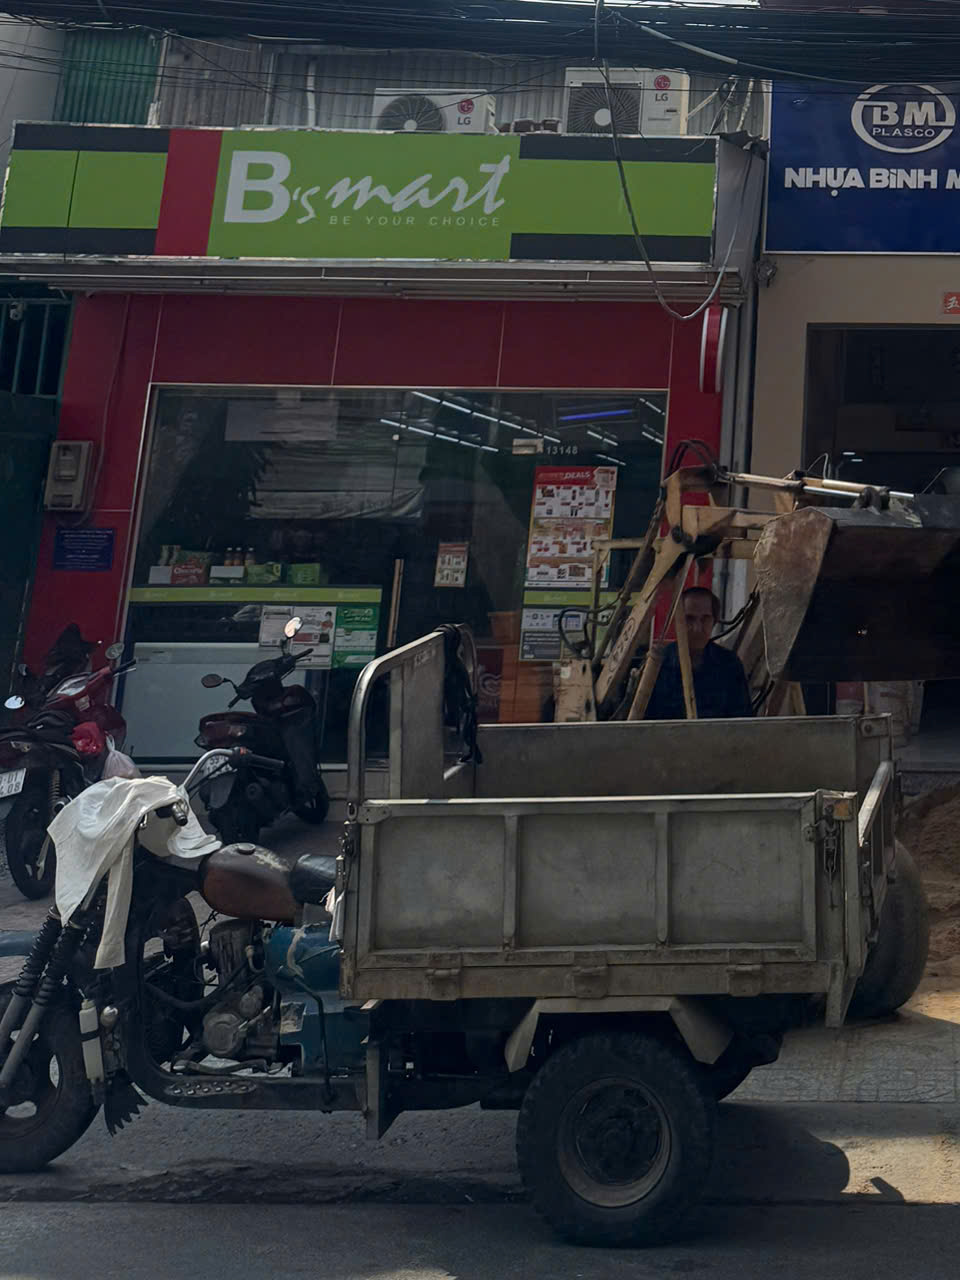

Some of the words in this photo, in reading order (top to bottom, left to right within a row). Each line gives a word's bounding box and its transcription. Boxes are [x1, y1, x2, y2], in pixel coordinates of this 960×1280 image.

[655, 93, 668, 102] LG
[457, 117, 471, 125] LG
[872, 127, 935, 137] PLASCO
[784, 167, 865, 197] NHỰA
[329, 216, 350, 225] BE
[366, 216, 416, 225] YOUR
[429, 216, 500, 226] CHOICE
